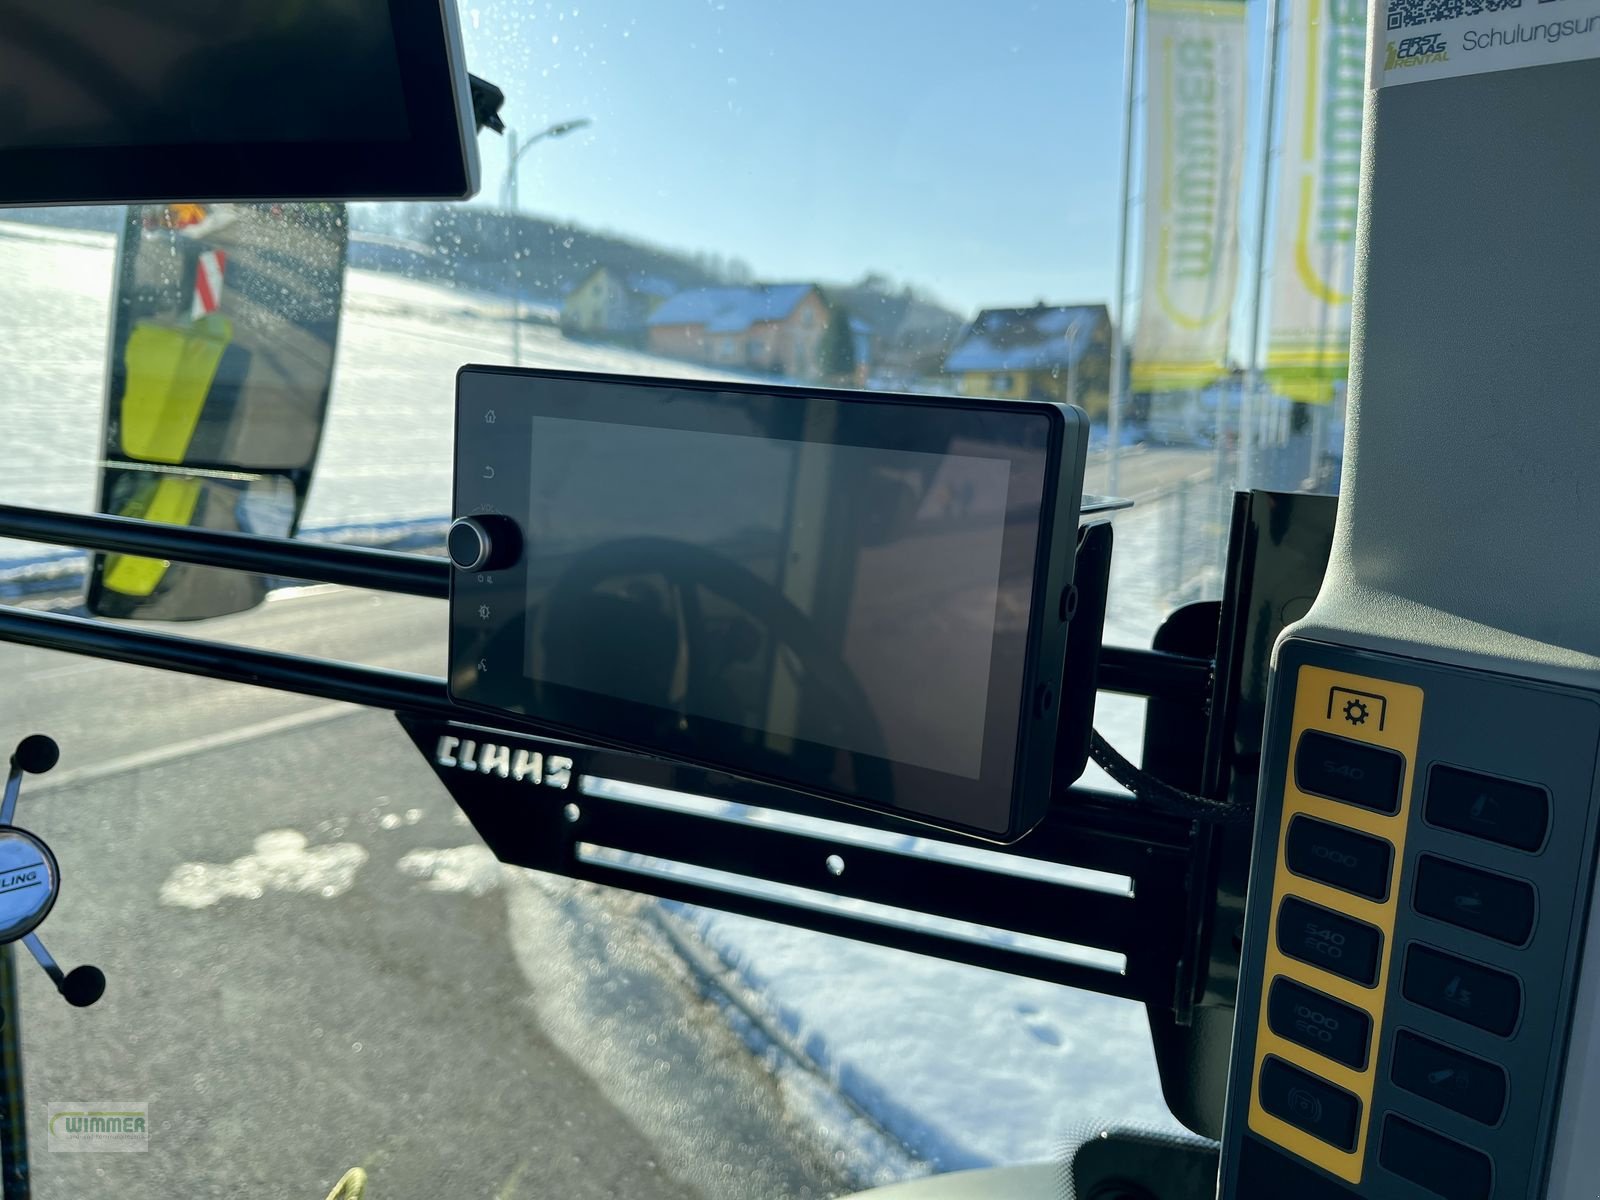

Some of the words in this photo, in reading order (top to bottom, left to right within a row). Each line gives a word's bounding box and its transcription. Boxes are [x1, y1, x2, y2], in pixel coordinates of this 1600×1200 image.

[1397, 42, 1447, 59] CLAAS
[1399, 33, 1442, 50] FIRST
[1394, 52, 1449, 69] RENTAL
[436, 735, 573, 790] CLAAS
[1323, 759, 1365, 780] 540
[1311, 844, 1358, 868] 1000
[1304, 923, 1345, 945] 540
[1304, 936, 1342, 958] ECO
[1294, 1004, 1339, 1031] 1000
[1295, 1020, 1333, 1042] ECO
